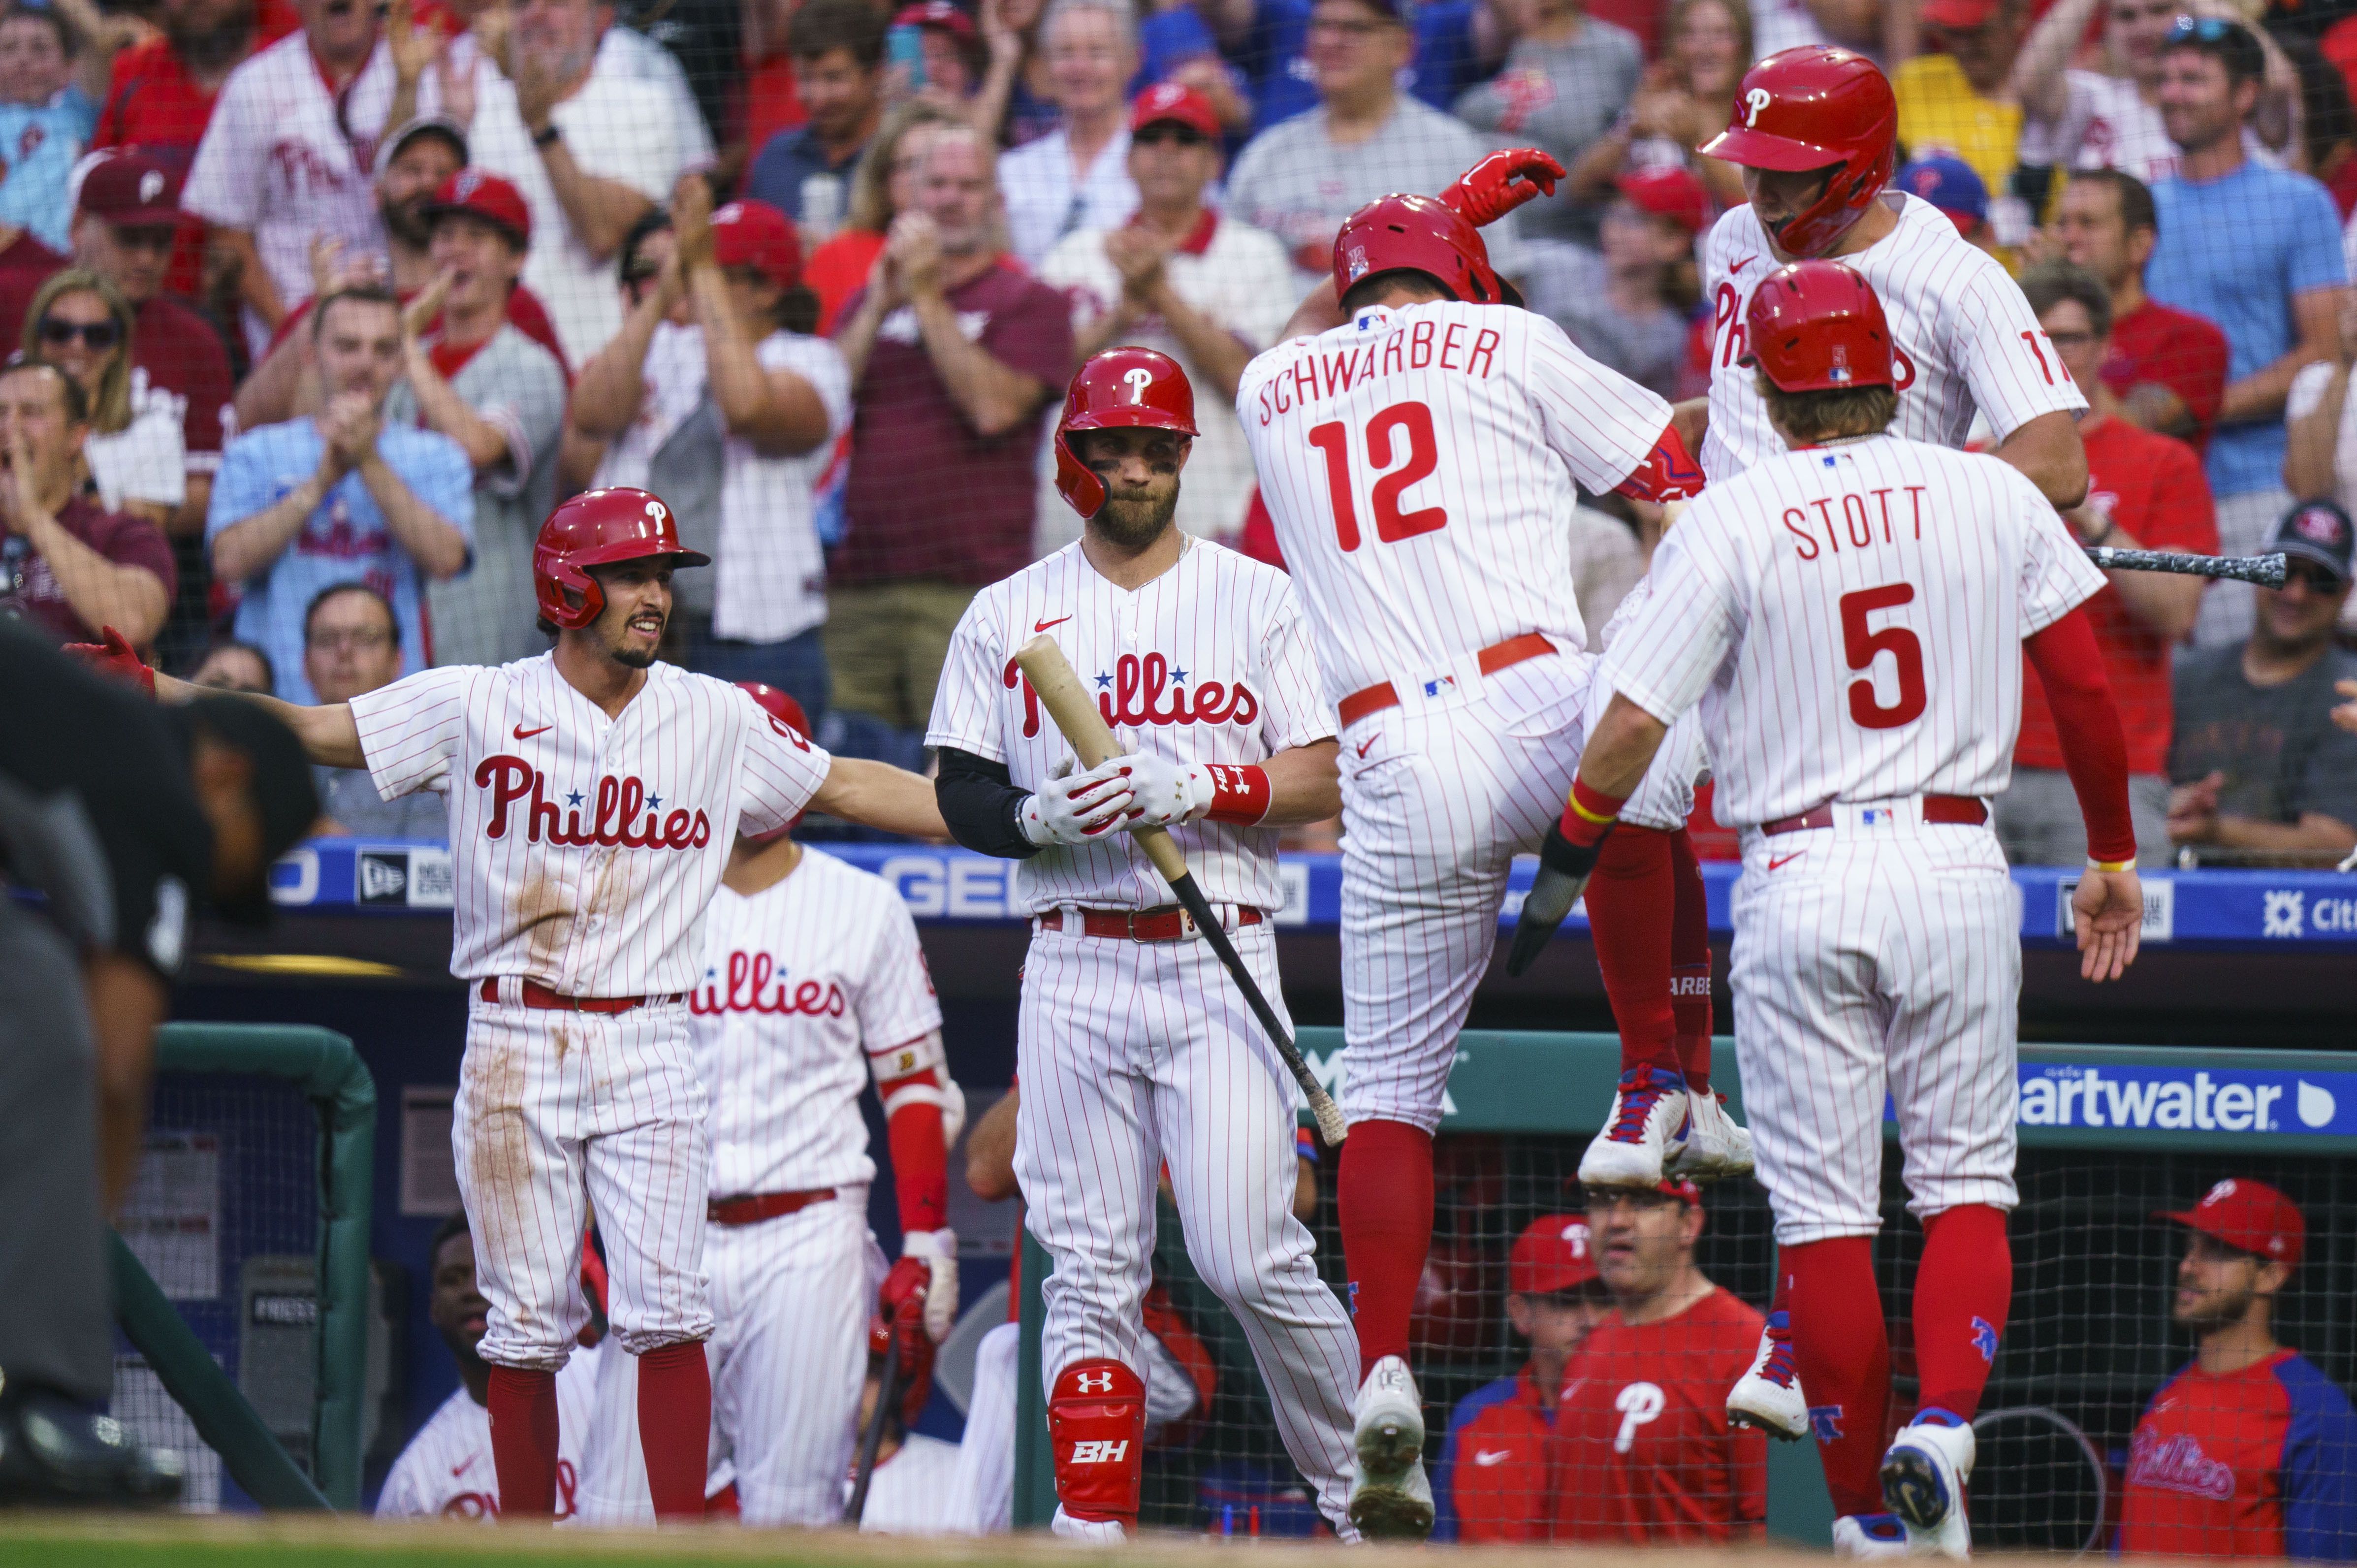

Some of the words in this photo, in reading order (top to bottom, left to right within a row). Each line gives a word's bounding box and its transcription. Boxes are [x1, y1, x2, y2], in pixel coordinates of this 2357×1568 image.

[1745, 88, 1770, 127] P
[1124, 368, 1152, 405] P
[1260, 320, 1500, 427] SCHWARBER
[1308, 401, 1448, 552] 12
[645, 501, 667, 536] P
[1783, 486, 1926, 560] STOTT
[1840, 582, 1927, 729] 5
[1004, 652, 1258, 738] Pillies
[475, 755, 711, 850] Phillies
[1211, 766, 1229, 793] BH
[1071, 1440, 1129, 1463] BH
[1615, 1381, 1665, 1454] P
